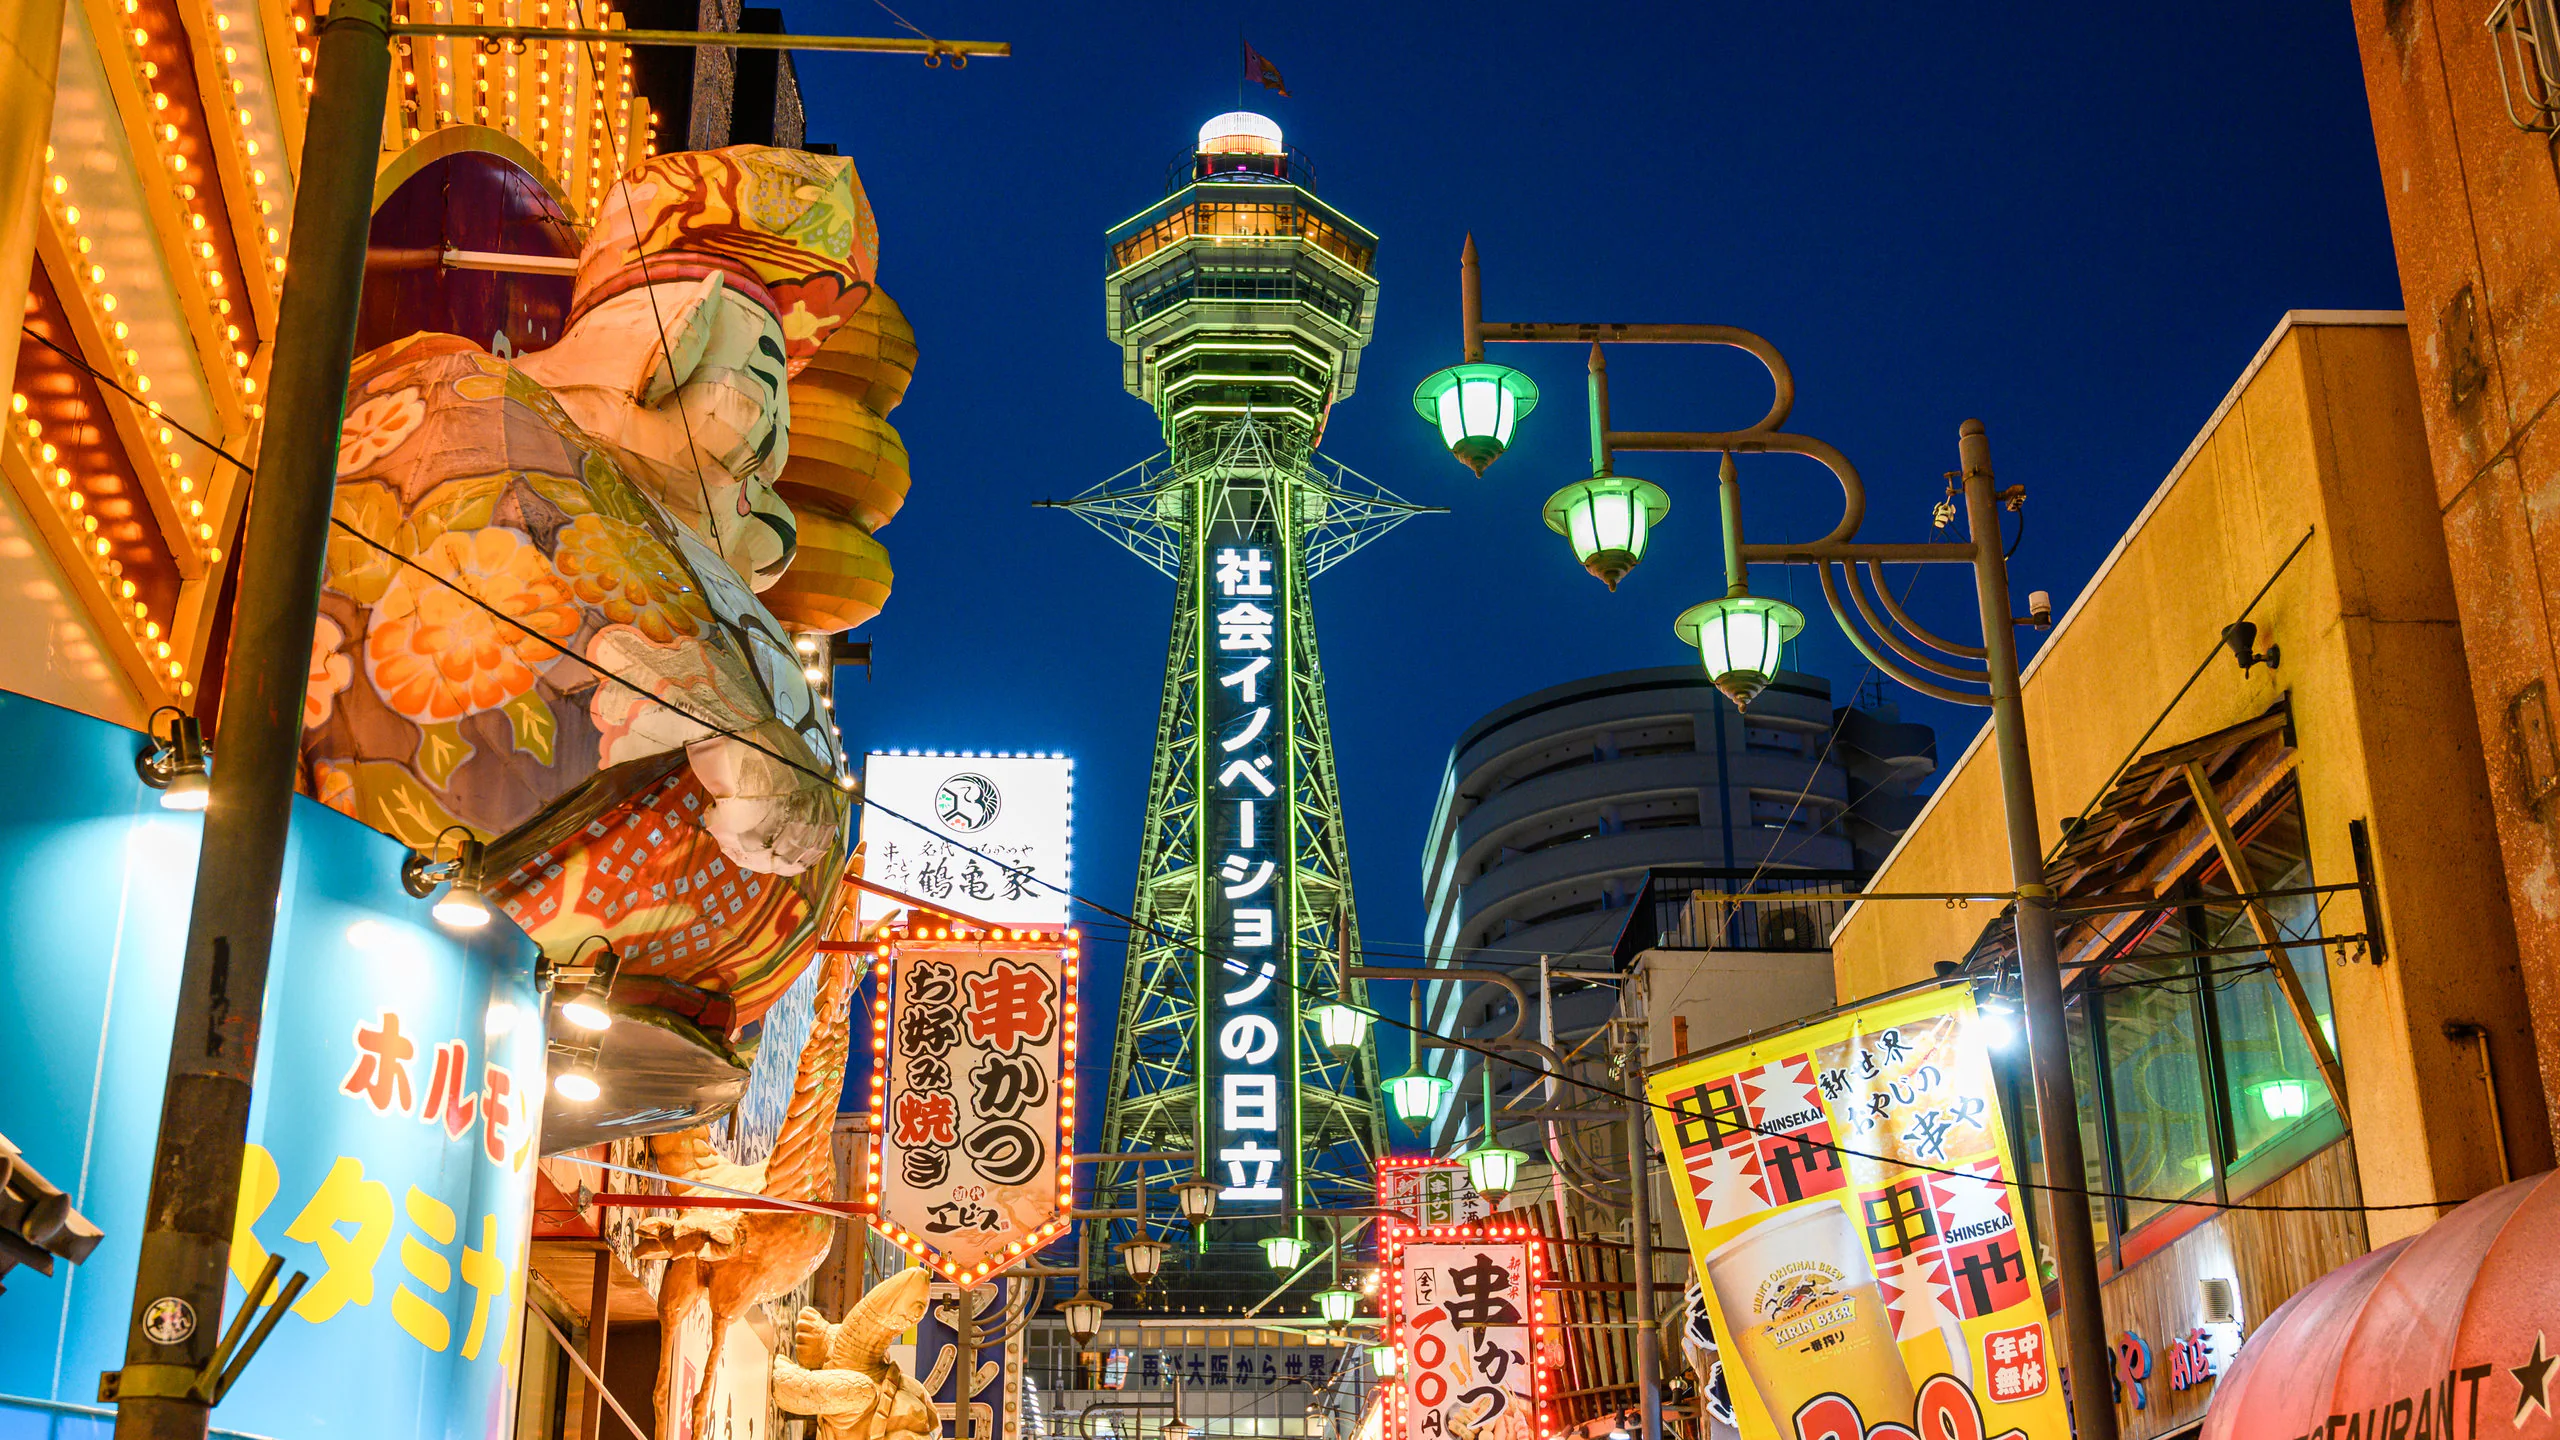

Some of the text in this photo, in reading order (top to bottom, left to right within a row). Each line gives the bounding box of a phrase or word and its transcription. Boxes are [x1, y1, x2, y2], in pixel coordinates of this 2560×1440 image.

[918, 840, 955, 857] 名代
[916, 857, 1041, 901] 鶴亀家
[1216, 548, 1283, 1200] 社会イノベーションの日立
[895, 961, 960, 1188] お好み焼き
[962, 958, 1056, 1186] 串かつ
[1820, 1030, 1913, 1100] 新世界
[1848, 1066, 1941, 1135] おやじの
[1756, 1106, 1824, 1137] SHINSEKAI
[1430, 1179, 1448, 1221] 串かつ
[1945, 1212, 2013, 1244] SHINSEKAI
[1416, 1271, 1434, 1302] 全て
[1506, 1255, 1521, 1300] 新世界
[1770, 1260, 1816, 1281] ORIGINAL
[1819, 1262, 1845, 1281] BREW
[1443, 1253, 1526, 1428] 串かつ
[1774, 1304, 1853, 1345] KIRIN BEER
[1800, 1330, 1845, 1353] 一番搾り
[1991, 1331, 2039, 1363] 年中
[1994, 1361, 2041, 1396] 無休
